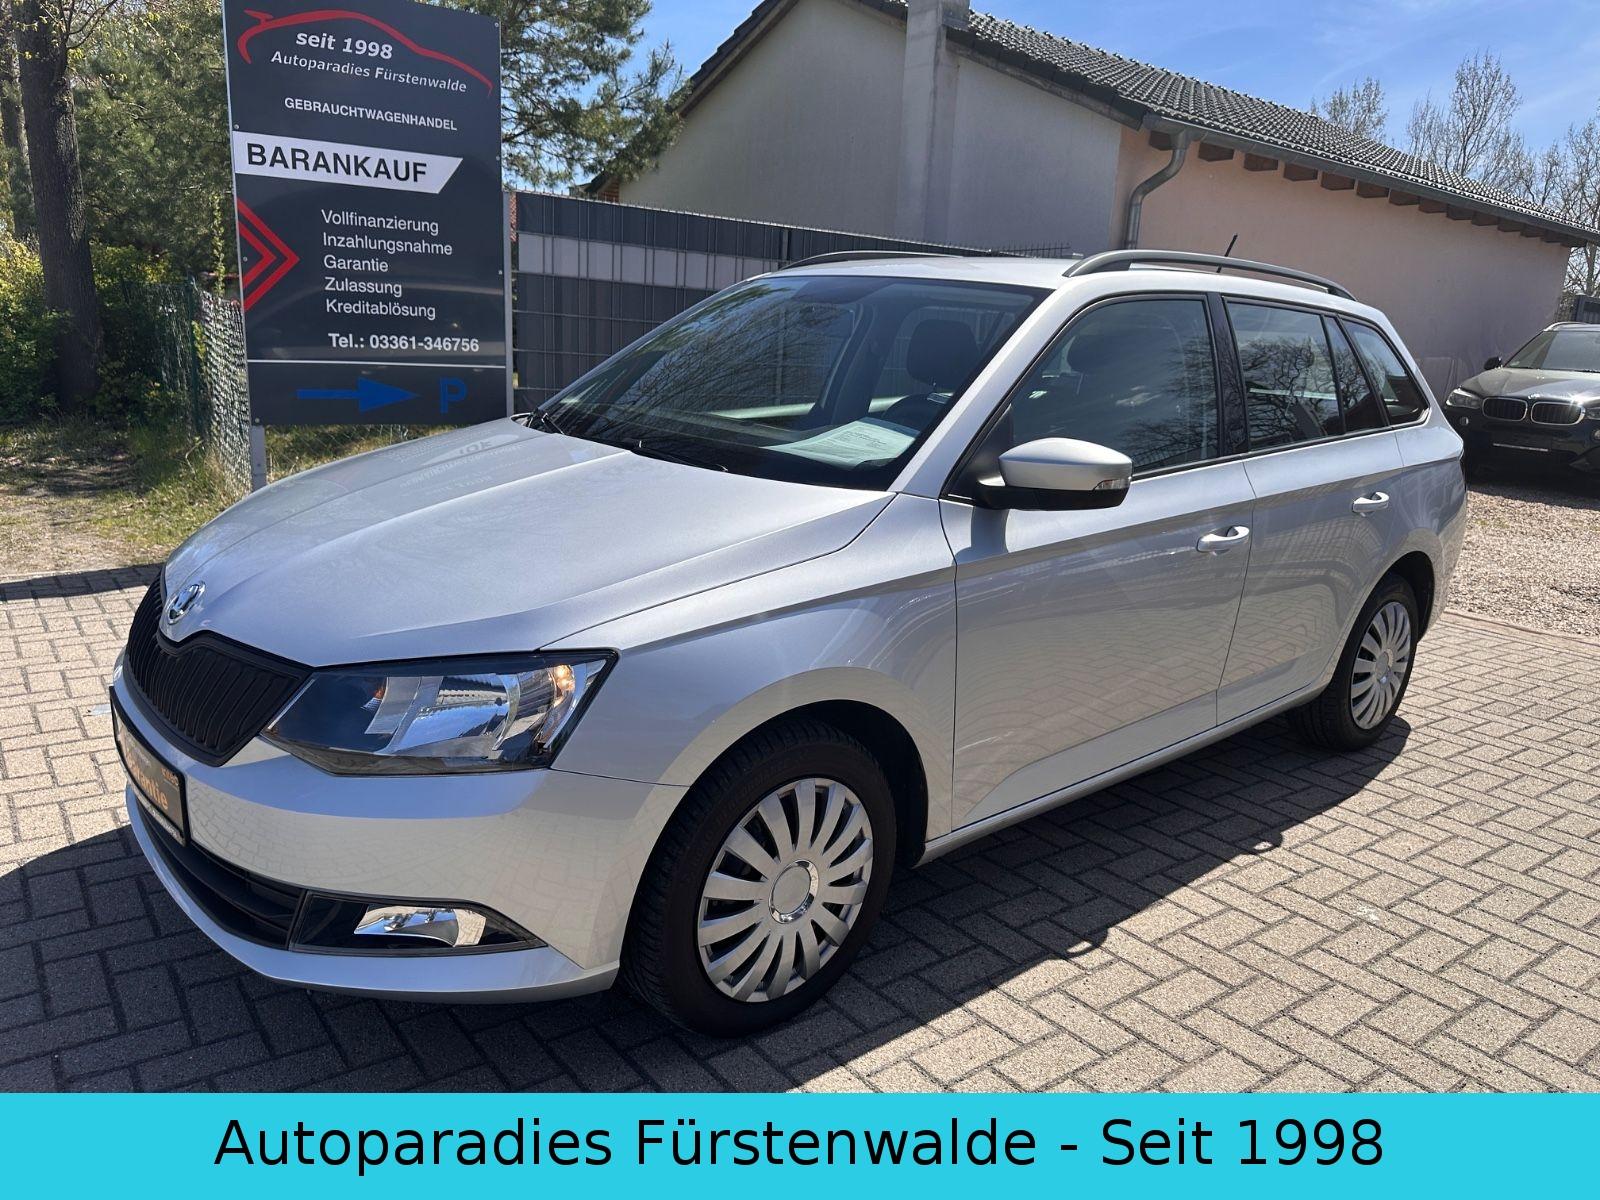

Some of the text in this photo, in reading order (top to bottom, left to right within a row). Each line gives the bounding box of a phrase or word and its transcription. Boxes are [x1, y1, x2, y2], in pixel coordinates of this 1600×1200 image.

[295, 32, 394, 60] seit 1998
[270, 50, 468, 93] Autoparadies Fürstenwalde
[284, 97, 458, 131] GEBRAUCHTWAGENHANDEL
[247, 142, 427, 183] BARANKAUF
[321, 209, 440, 236] Vollfinanzierung
[323, 232, 453, 256] Inzahlungsnahme
[323, 255, 389, 272] Garantie
[324, 277, 403, 297] Zulassung
[326, 299, 437, 321] Kreditablösung
[328, 332, 480, 352] Tel.: 03361-346756
